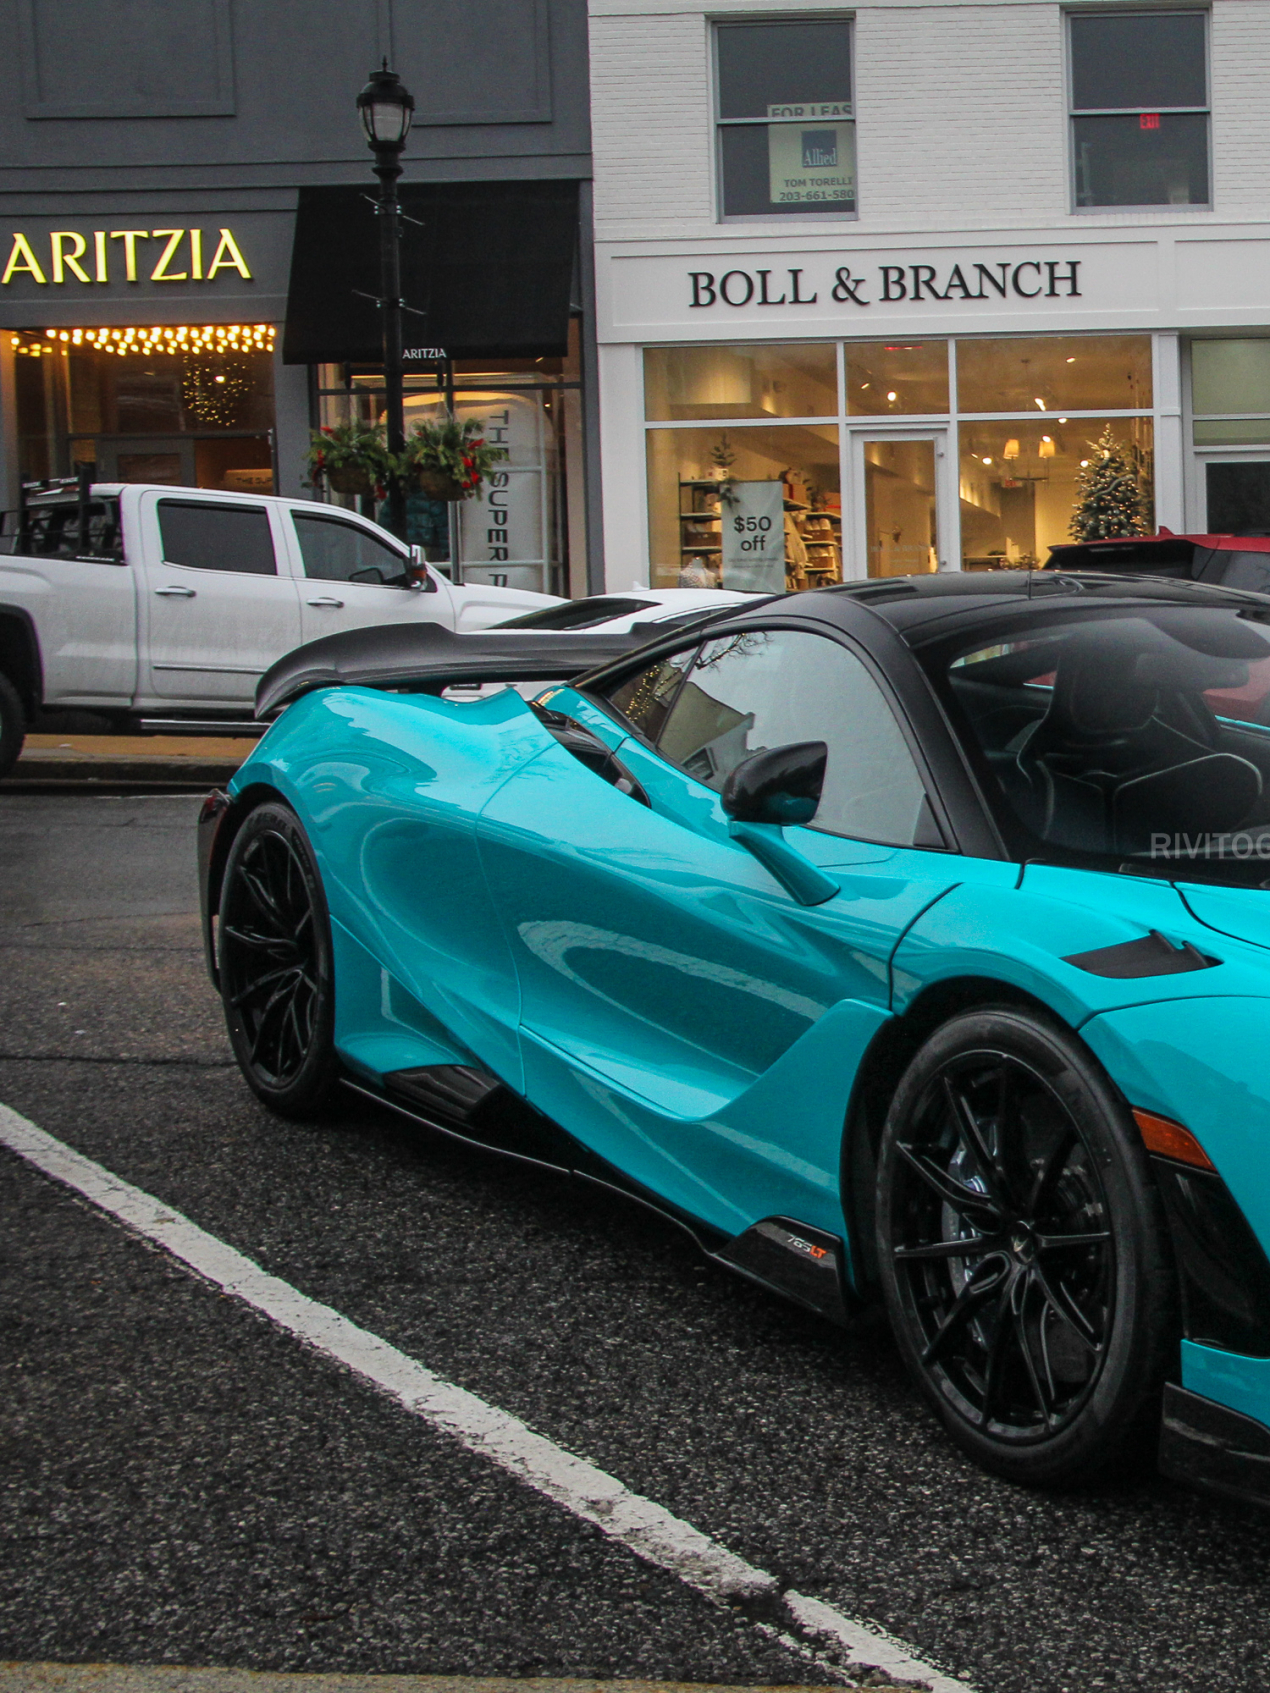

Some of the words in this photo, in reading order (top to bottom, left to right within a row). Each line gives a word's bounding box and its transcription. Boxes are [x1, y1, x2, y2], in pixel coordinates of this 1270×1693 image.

[771, 106, 804, 117] FOR
[803, 148, 837, 166] Allied
[784, 179, 806, 187] TOM
[809, 177, 852, 186] TORELLI
[1, 228, 252, 284] ARITZIA
[687, 269, 818, 308] BOLL
[830, 266, 871, 307] &
[878, 260, 1082, 302] BRANCH
[402, 347, 447, 359] ARITZIA
[487, 472, 509, 561] SUPER
[734, 515, 771, 533] $50
[741, 535, 766, 551] off
[787, 1233, 828, 1259] 765LT
